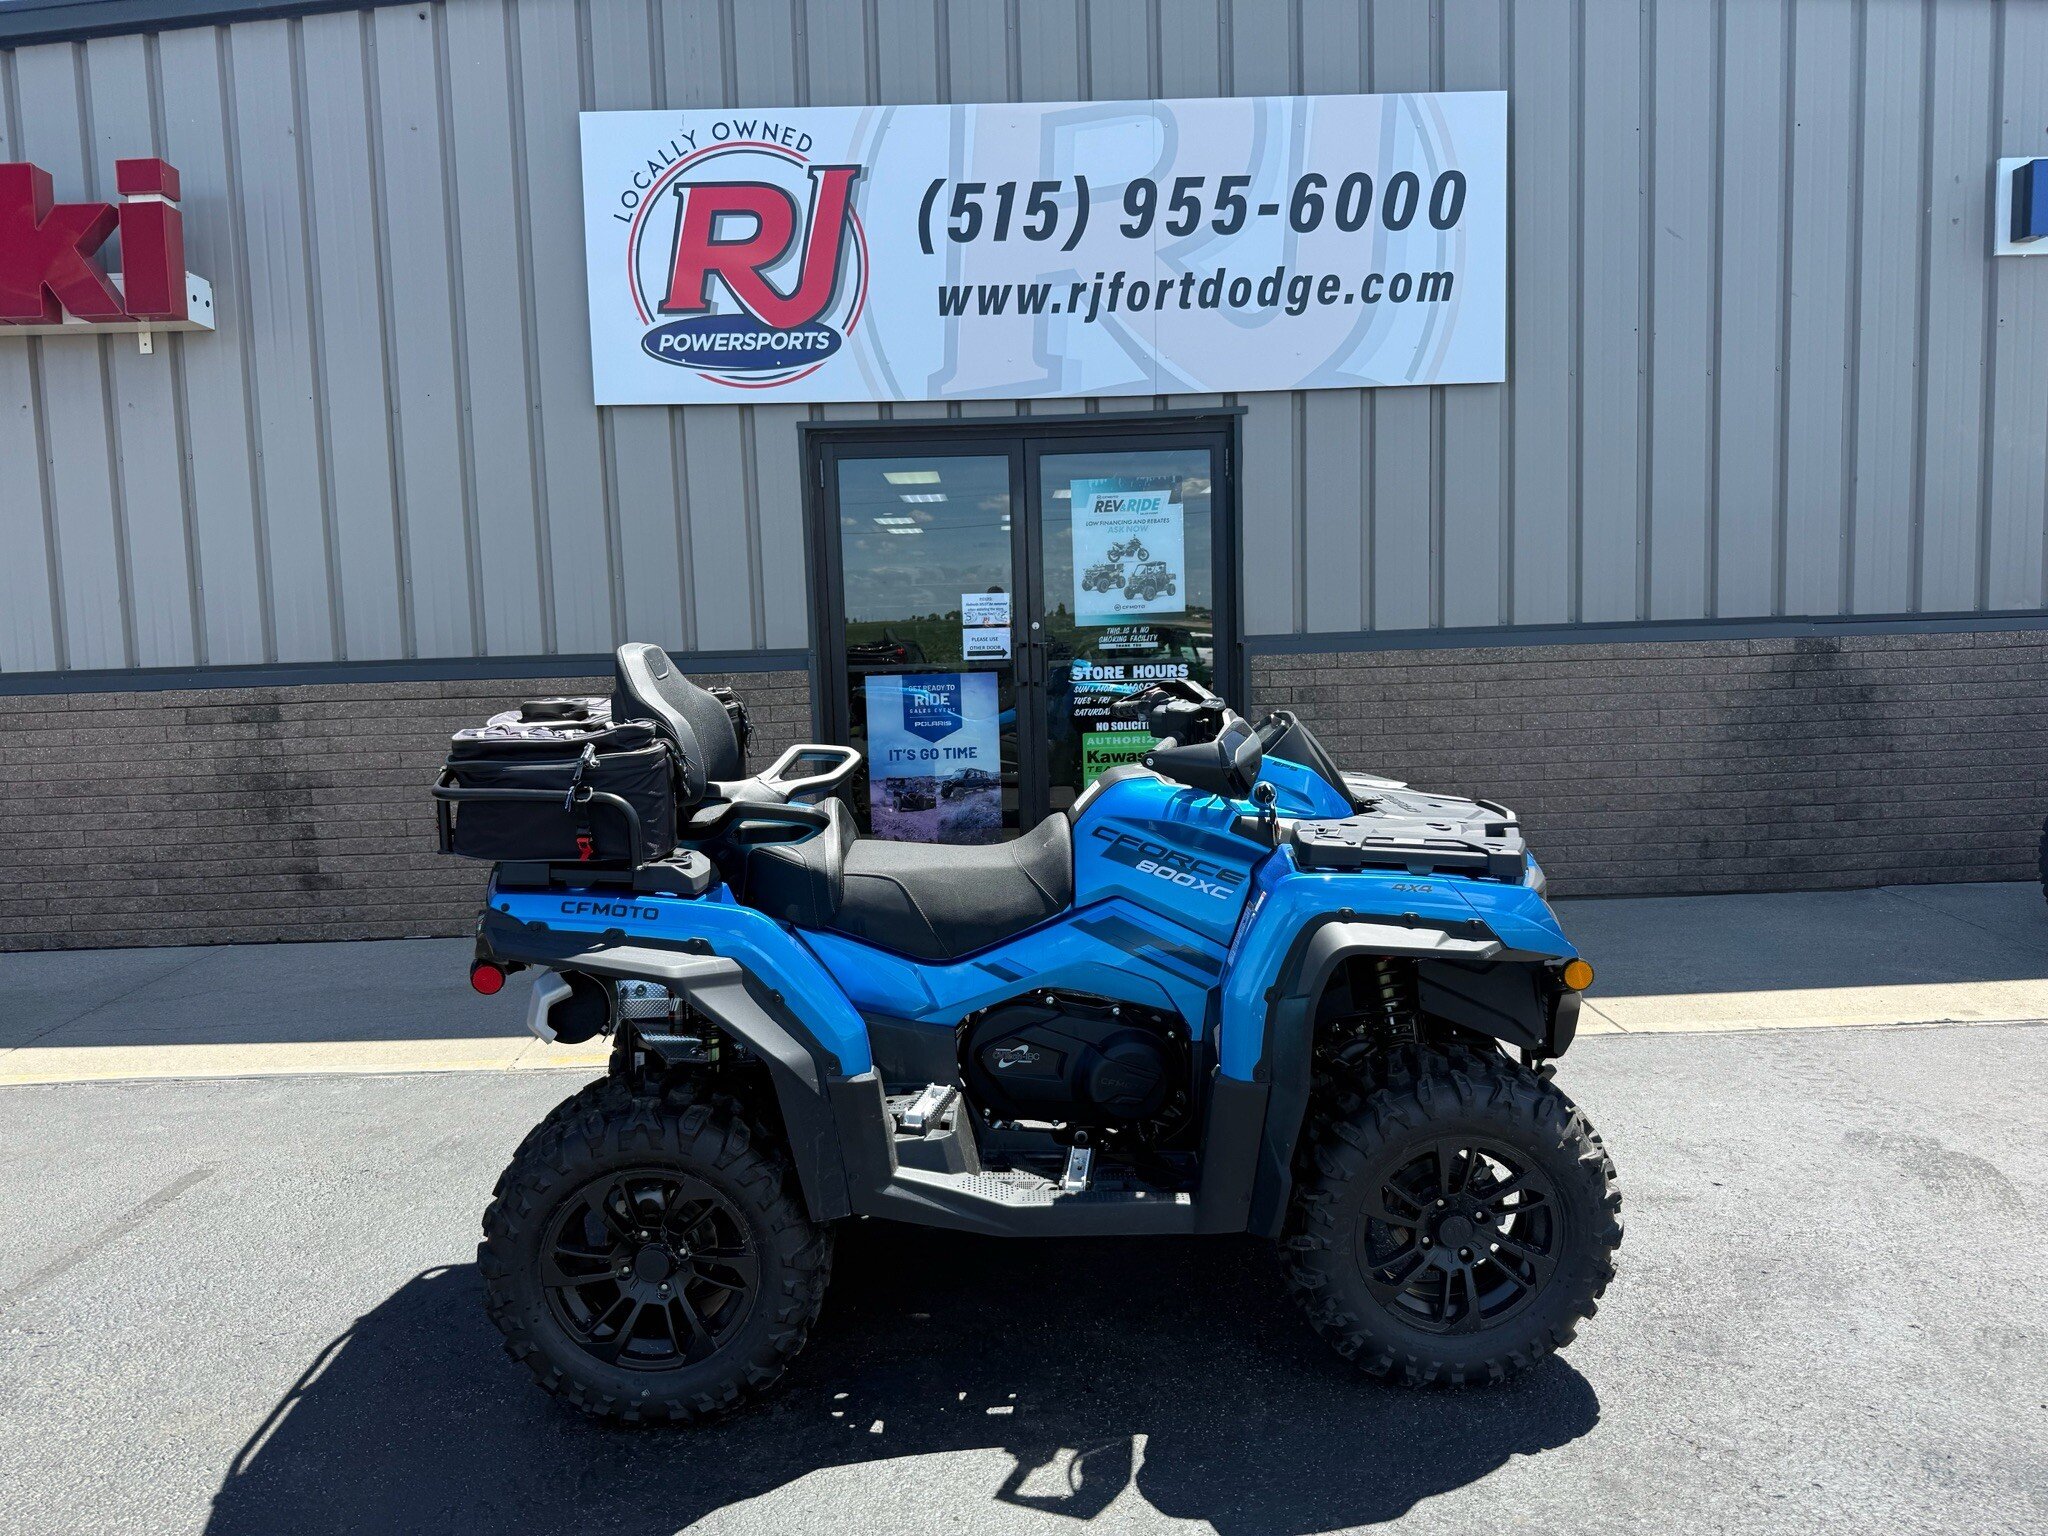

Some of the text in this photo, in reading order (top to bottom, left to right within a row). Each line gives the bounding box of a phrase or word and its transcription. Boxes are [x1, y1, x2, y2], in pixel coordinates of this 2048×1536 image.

[614, 119, 813, 223] LOCALLY OWNED
[918, 170, 1467, 254] (515) 955-6000
[657, 164, 866, 331] RJ
[938, 266, 1455, 323] www.rjfortdodge.com
[659, 332, 830, 352] POWERSPORTS
[1107, 526, 1124, 534] ASK
[1099, 634, 1158, 643] SMOKING FACILITY
[1106, 627, 1121, 635] THIS
[1072, 664, 1189, 680] STORE HOURS
[923, 684, 945, 692] READY
[1073, 685, 1090, 693] SUN
[914, 692, 950, 707] RIDE
[1098, 696, 1111, 704] FRI
[1073, 707, 1110, 716] SATURDA
[1096, 721, 1109, 731] NO
[1087, 735, 1159, 746] AUTHORIZ
[889, 746, 978, 761] IT'S GO TIME
[1087, 750, 1145, 764] Kawas
[1092, 826, 1248, 886] CFORCE
[1135, 859, 1235, 900] 800XC
[560, 901, 659, 921] CFMOTO
